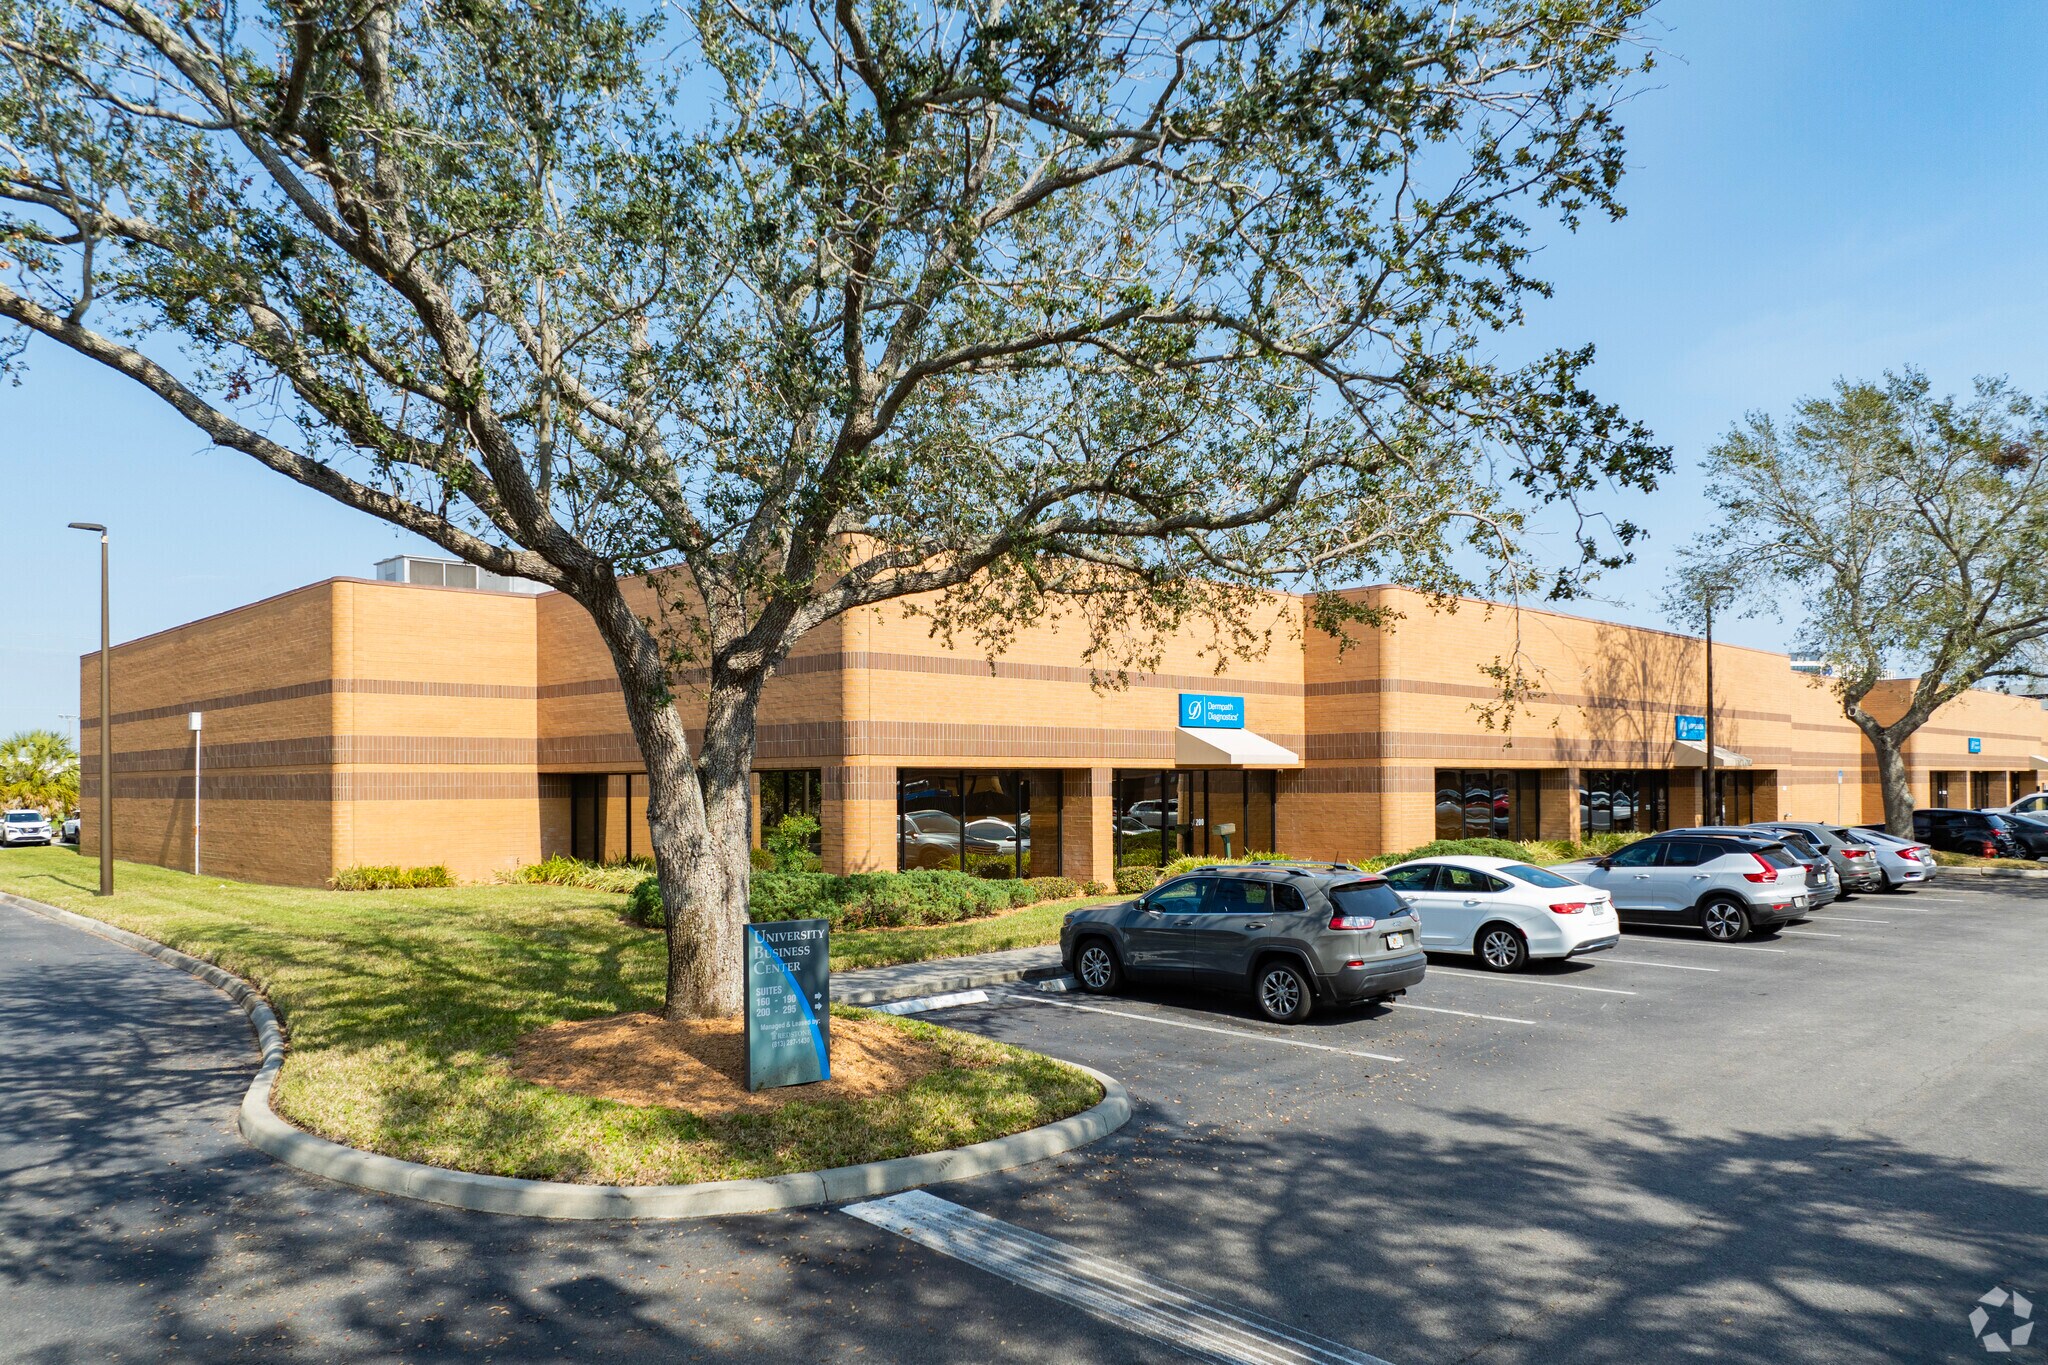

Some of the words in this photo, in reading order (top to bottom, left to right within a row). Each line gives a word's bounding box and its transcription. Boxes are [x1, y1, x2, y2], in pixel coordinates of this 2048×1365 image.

[1207, 701, 1234, 712] Dermpath
[754, 929, 825, 944] UNIVERSITY
[754, 945, 811, 960] BUSINESS
[753, 961, 801, 975] CENTER
[755, 985, 783, 996] SUITES
[756, 997, 771, 1006] 160
[782, 994, 797, 1003] 190
[756, 1008, 771, 1017] 200
[782, 1005, 797, 1014] 295
[760, 1022, 786, 1031] Managed
[792, 1019, 811, 1027] Leased
[777, 1030, 812, 1039] REDSTONE
